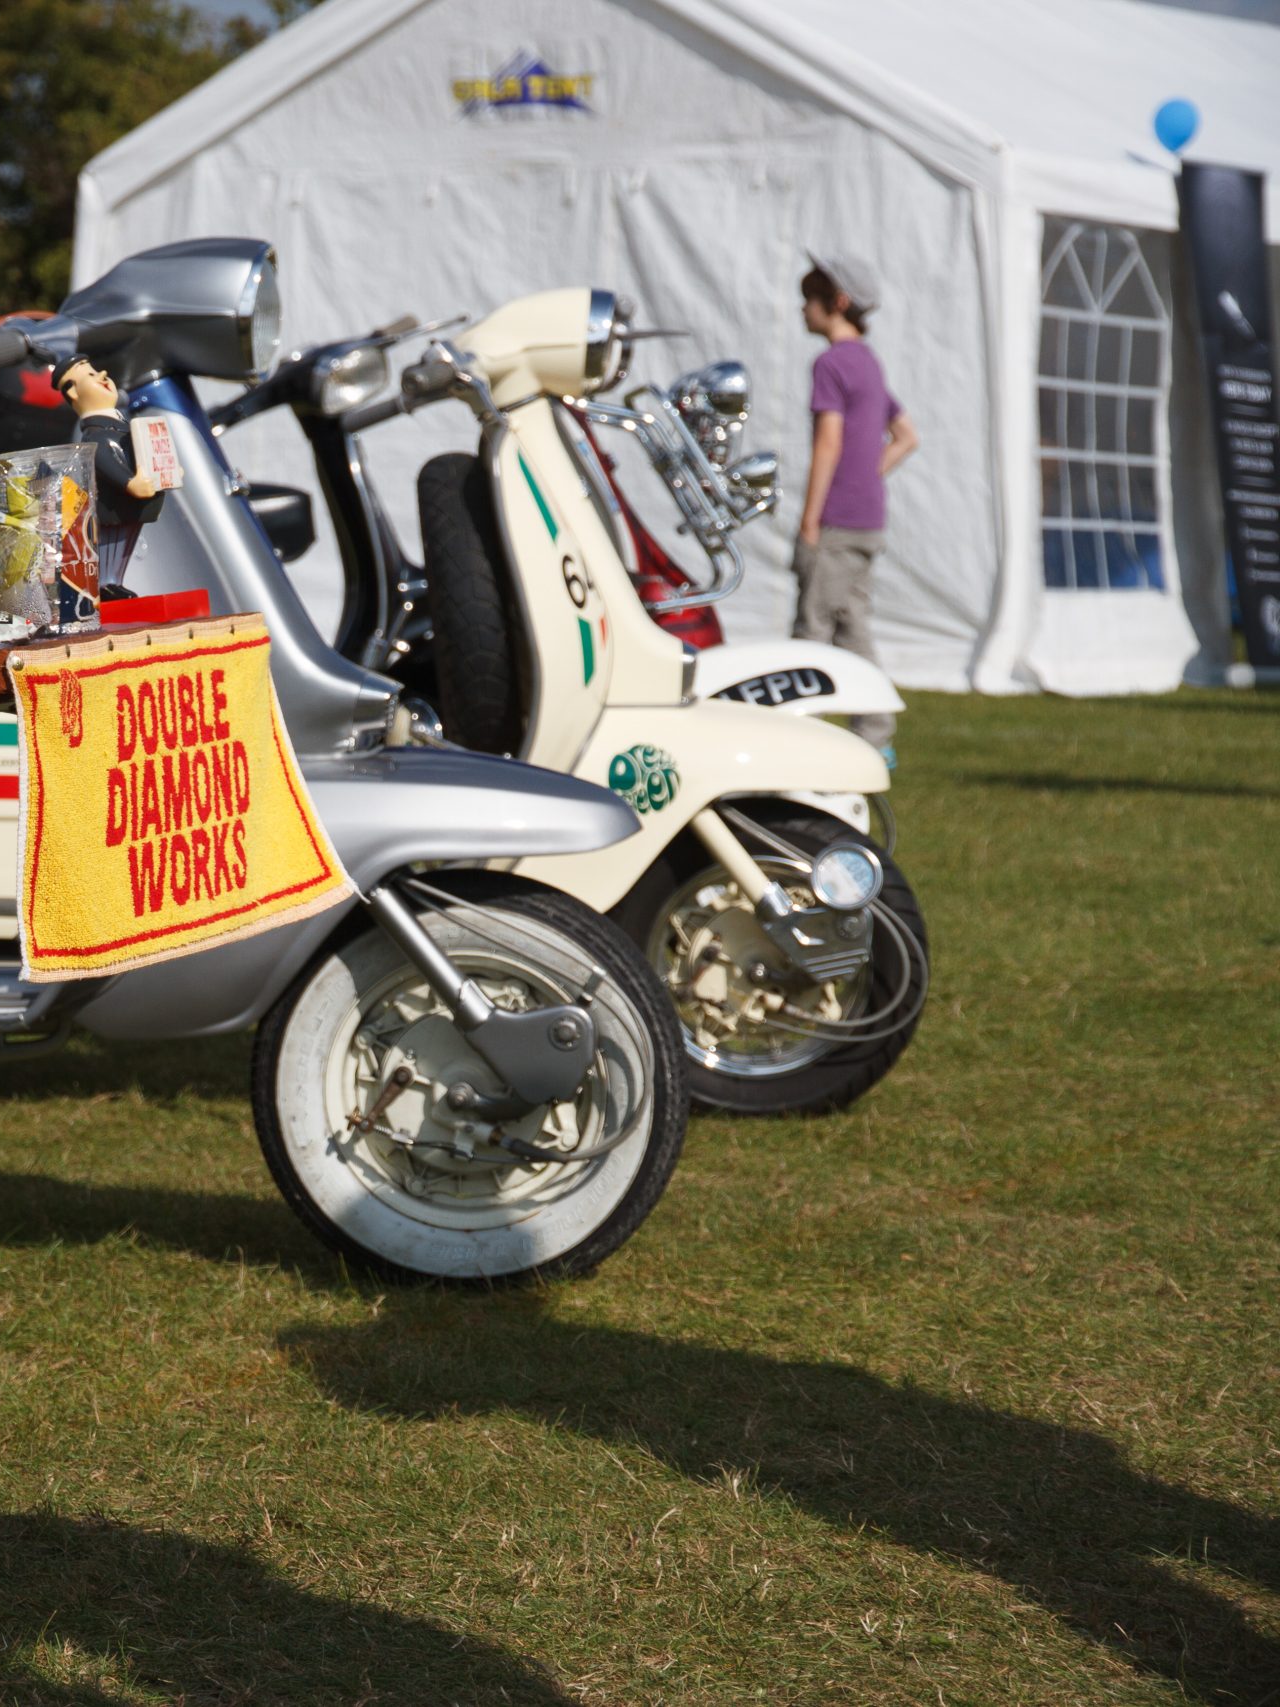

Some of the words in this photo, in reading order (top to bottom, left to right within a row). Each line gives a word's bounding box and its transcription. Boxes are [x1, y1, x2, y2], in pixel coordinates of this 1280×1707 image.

[562, 554, 594, 609] 6
[116, 669, 230, 763] DOUBLE
[719, 668, 822, 706] FPU
[105, 740, 250, 848] DIAMOND
[128, 818, 248, 918] WORKS
